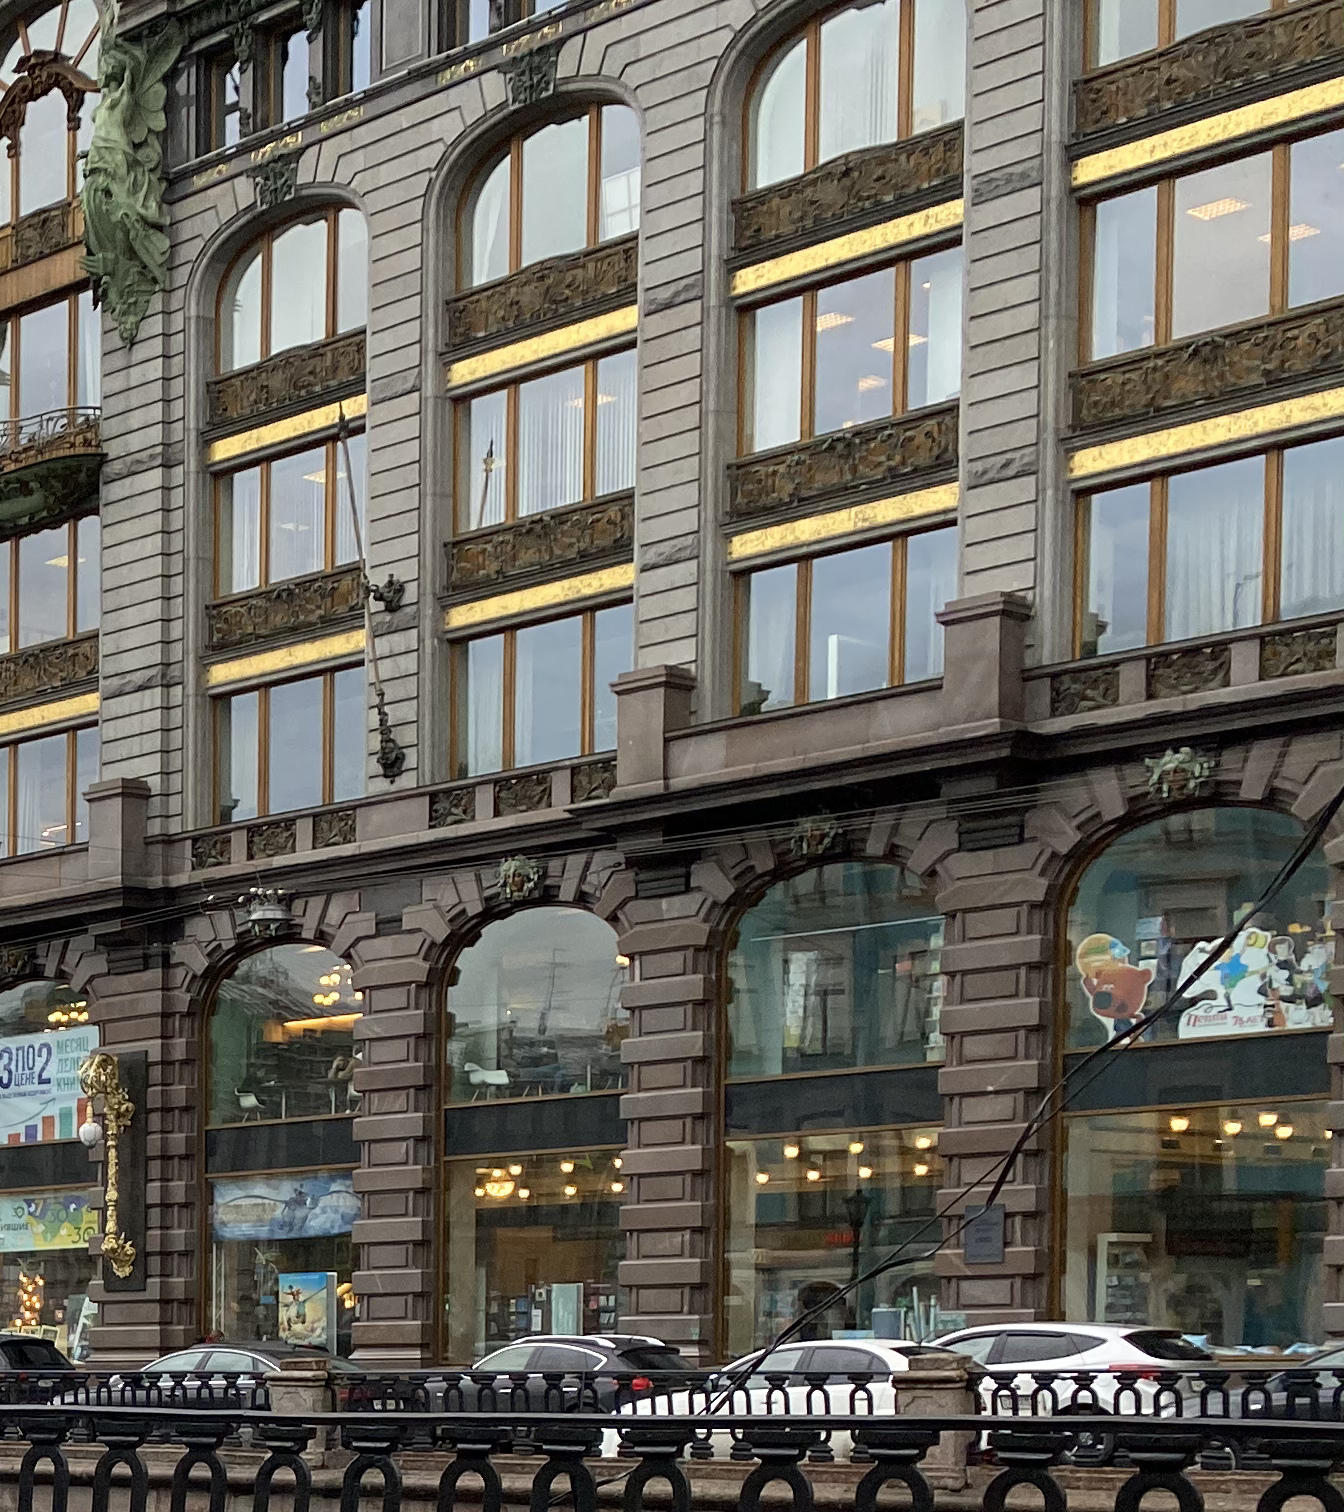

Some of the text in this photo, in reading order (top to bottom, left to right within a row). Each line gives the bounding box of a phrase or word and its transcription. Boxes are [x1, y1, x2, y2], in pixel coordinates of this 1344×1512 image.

[56, 1036, 89, 1054] МЕСЯЦ
[15, 1043, 35, 1072] ПО
[37, 1042, 53, 1085] 2
[14, 1071, 35, 1087] ЦЕНЕ
